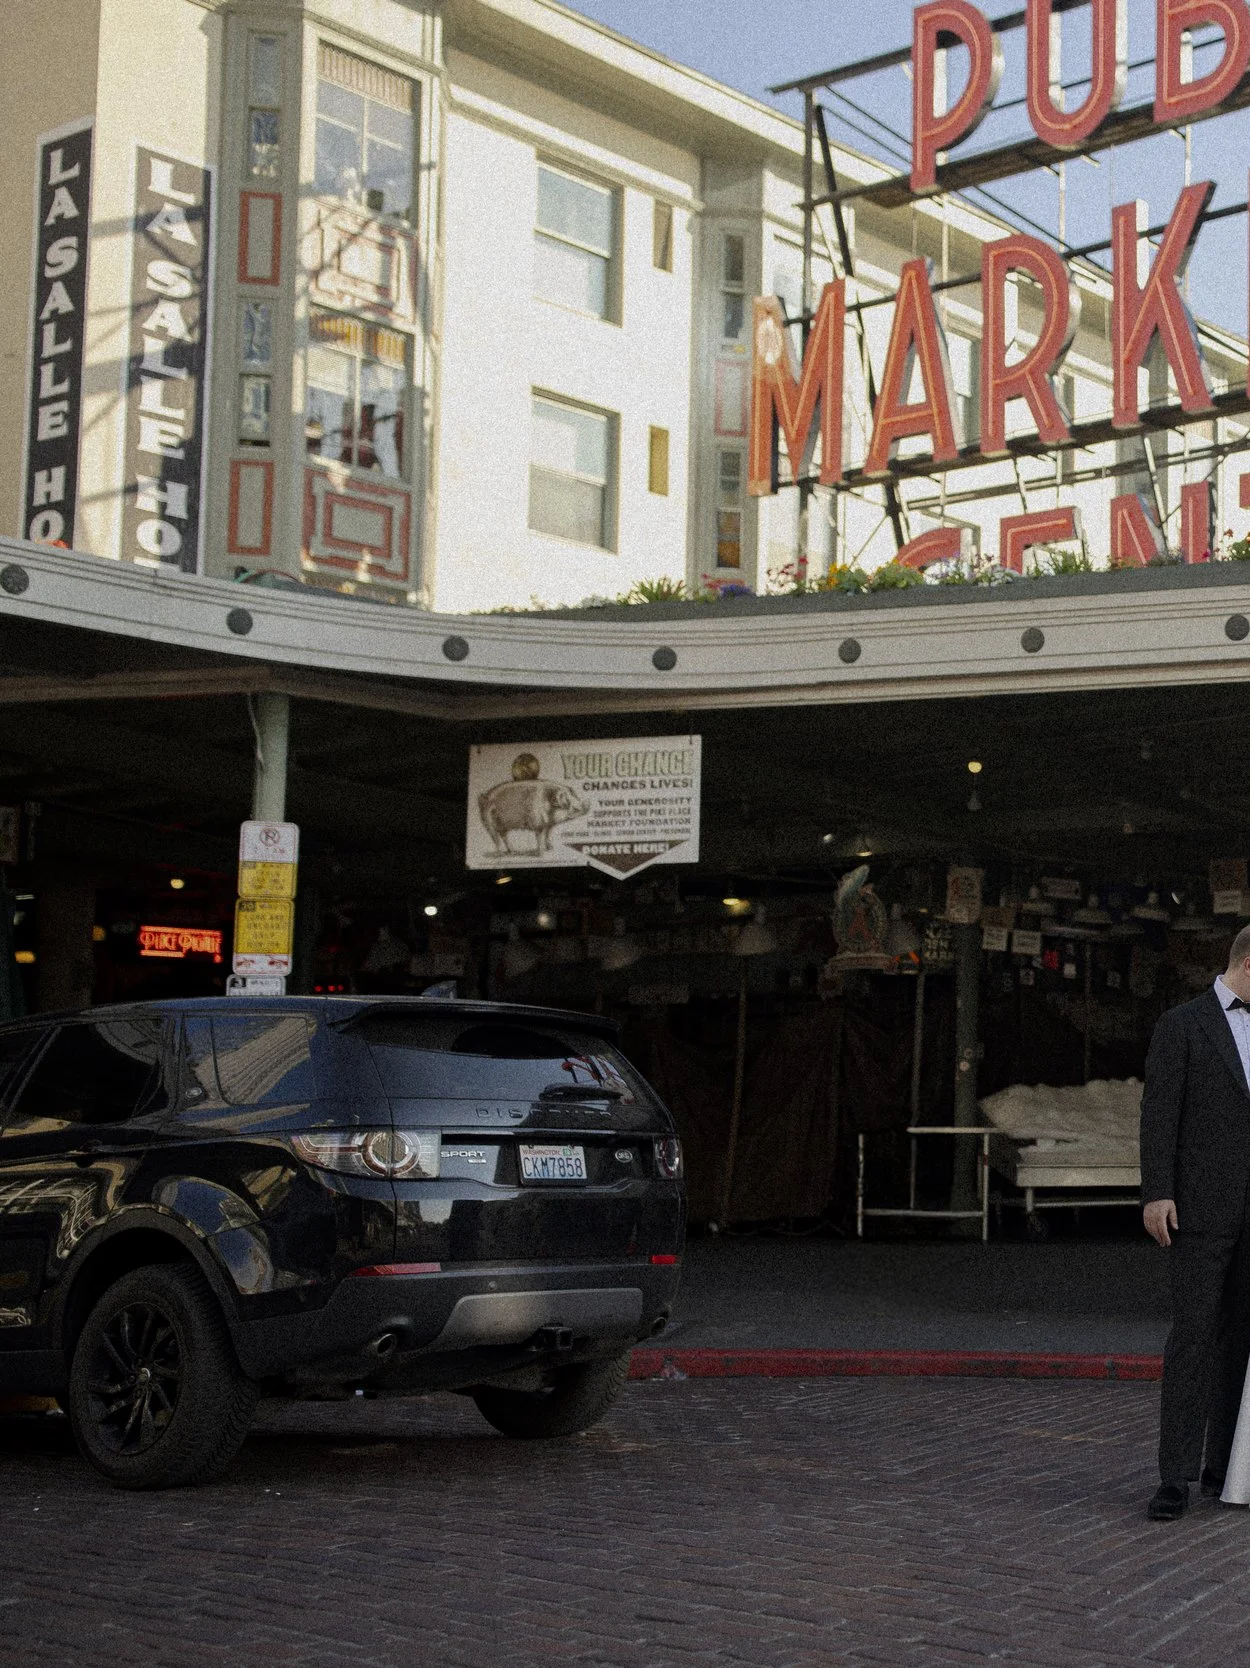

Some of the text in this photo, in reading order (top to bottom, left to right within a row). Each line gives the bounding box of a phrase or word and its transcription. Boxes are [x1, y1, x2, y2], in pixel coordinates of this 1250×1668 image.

[560, 751, 694, 780] YOUR CHANGE
[583, 779, 693, 791] CHANGES LIVES!
[582, 844, 631, 855] DONATE
[441, 1150, 486, 1158] SPORT
[523, 1157, 583, 1178] CKM7858
